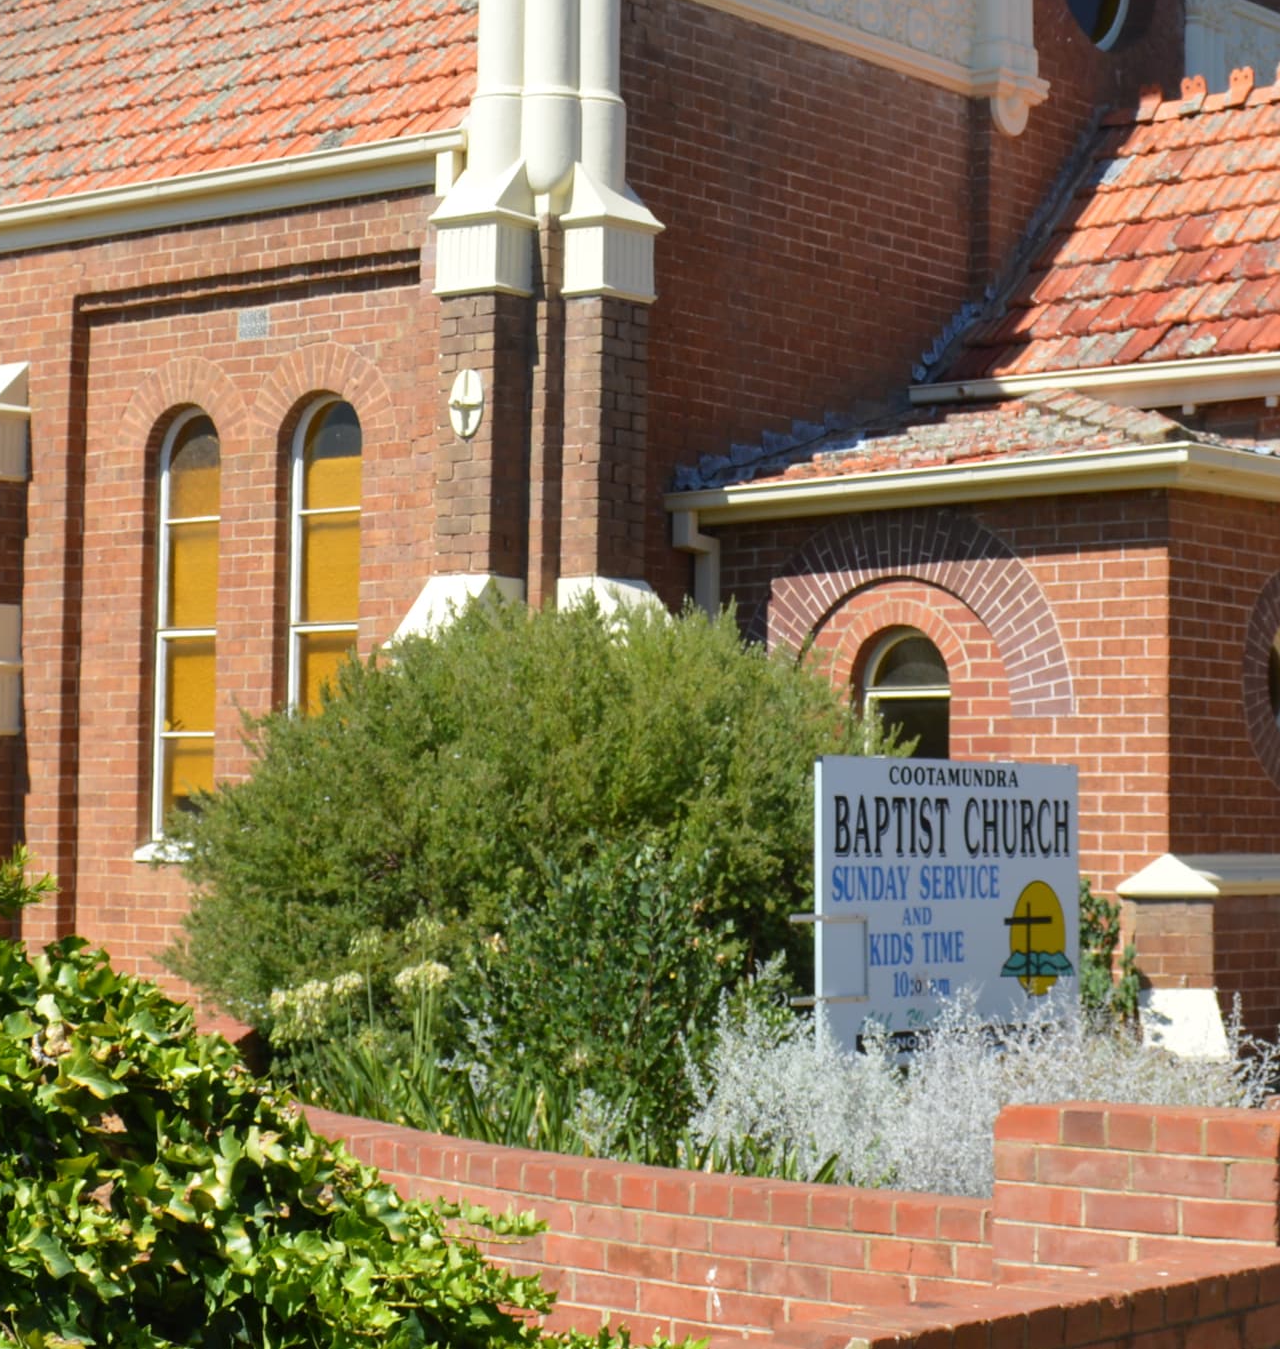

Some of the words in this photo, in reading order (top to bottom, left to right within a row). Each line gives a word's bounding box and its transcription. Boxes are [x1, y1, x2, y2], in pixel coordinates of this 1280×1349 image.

[889, 766, 1019, 788] COOTAMUNDRA
[834, 795, 950, 858] BAPTIST
[963, 798, 1070, 859] CHURCH
[832, 865, 910, 902] SUNDAY
[919, 865, 1000, 900] SERVICE
[902, 907, 932, 926] AND
[869, 933, 914, 967] KIDS
[921, 931, 965, 964] TIME
